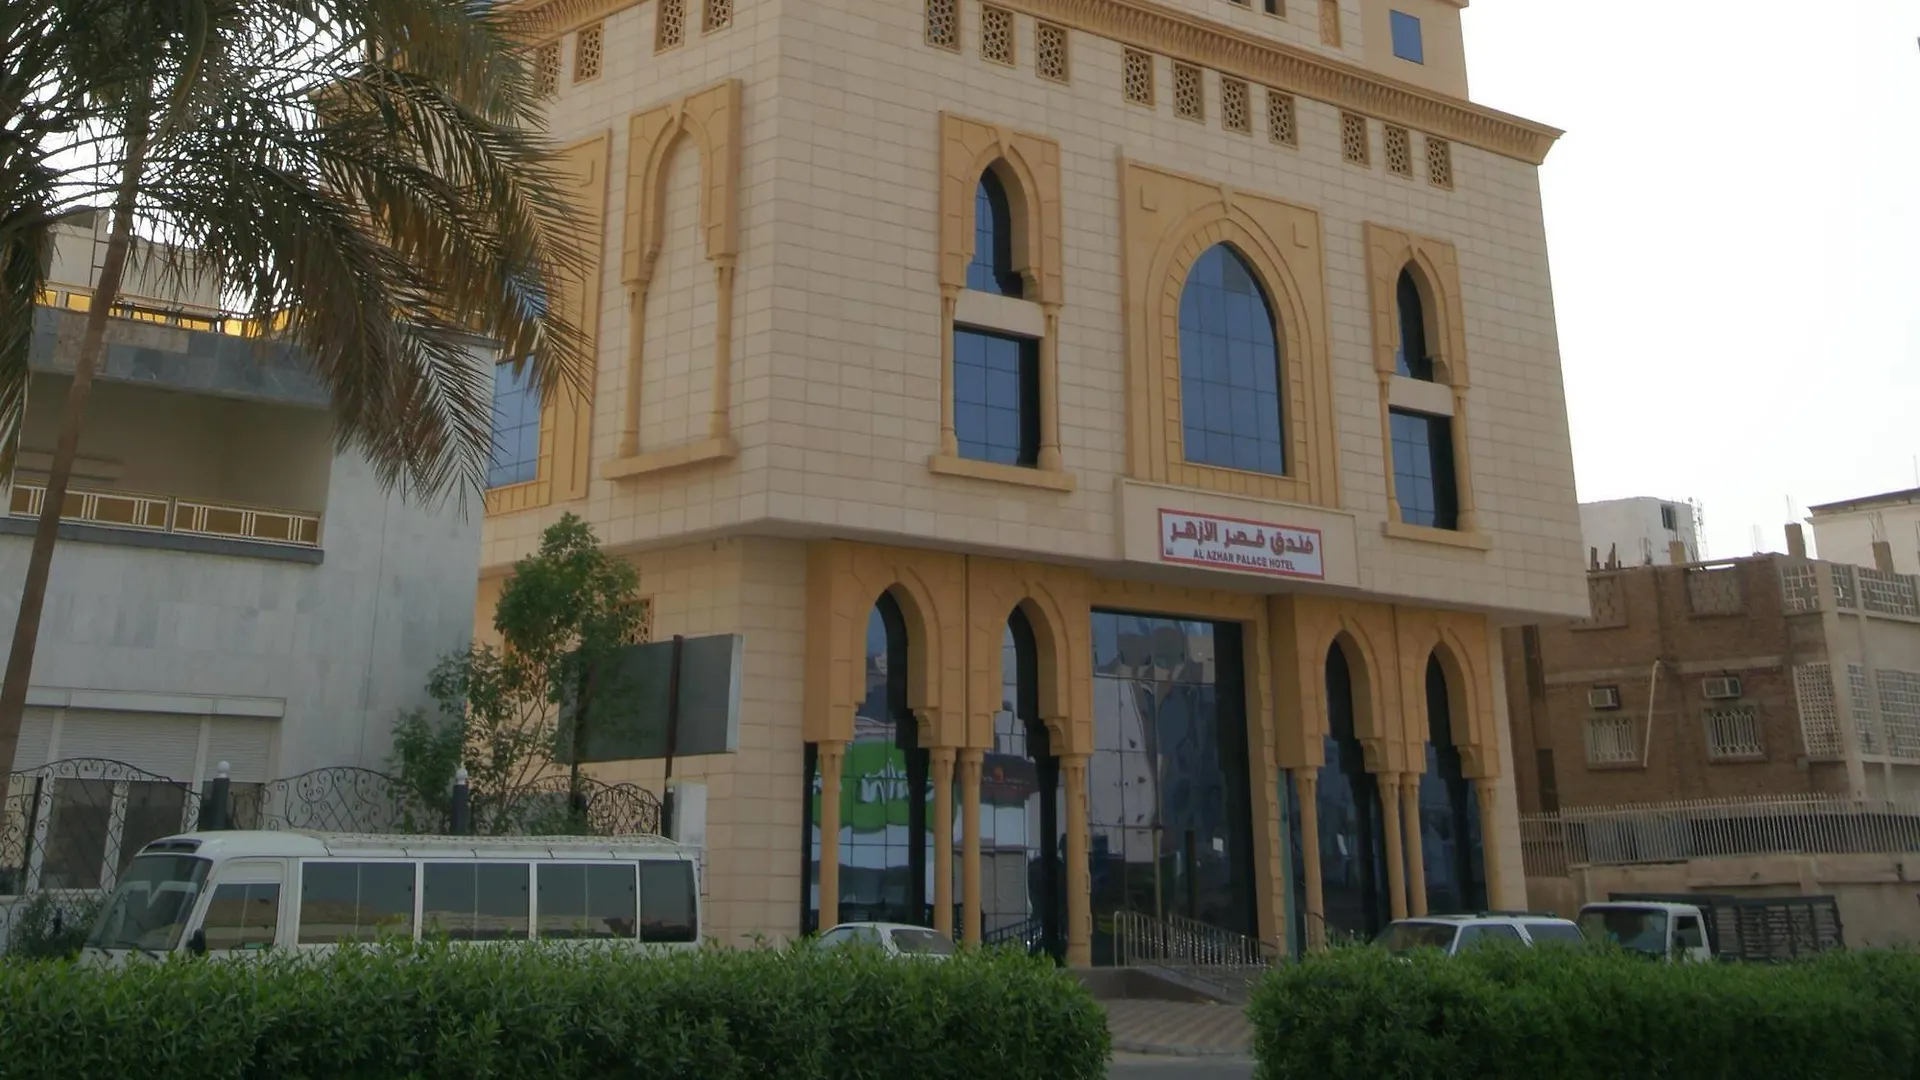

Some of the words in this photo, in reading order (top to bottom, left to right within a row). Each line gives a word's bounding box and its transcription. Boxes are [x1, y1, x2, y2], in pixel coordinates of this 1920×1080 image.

[1224, 528, 1265, 549] قصر
[1270, 531, 1314, 555] فندق
[1193, 548, 1204, 559] AL
[1207, 550, 1234, 563] AZHAR
[1236, 554, 1267, 568] PALACE
[1269, 557, 1296, 571] HOTEL
